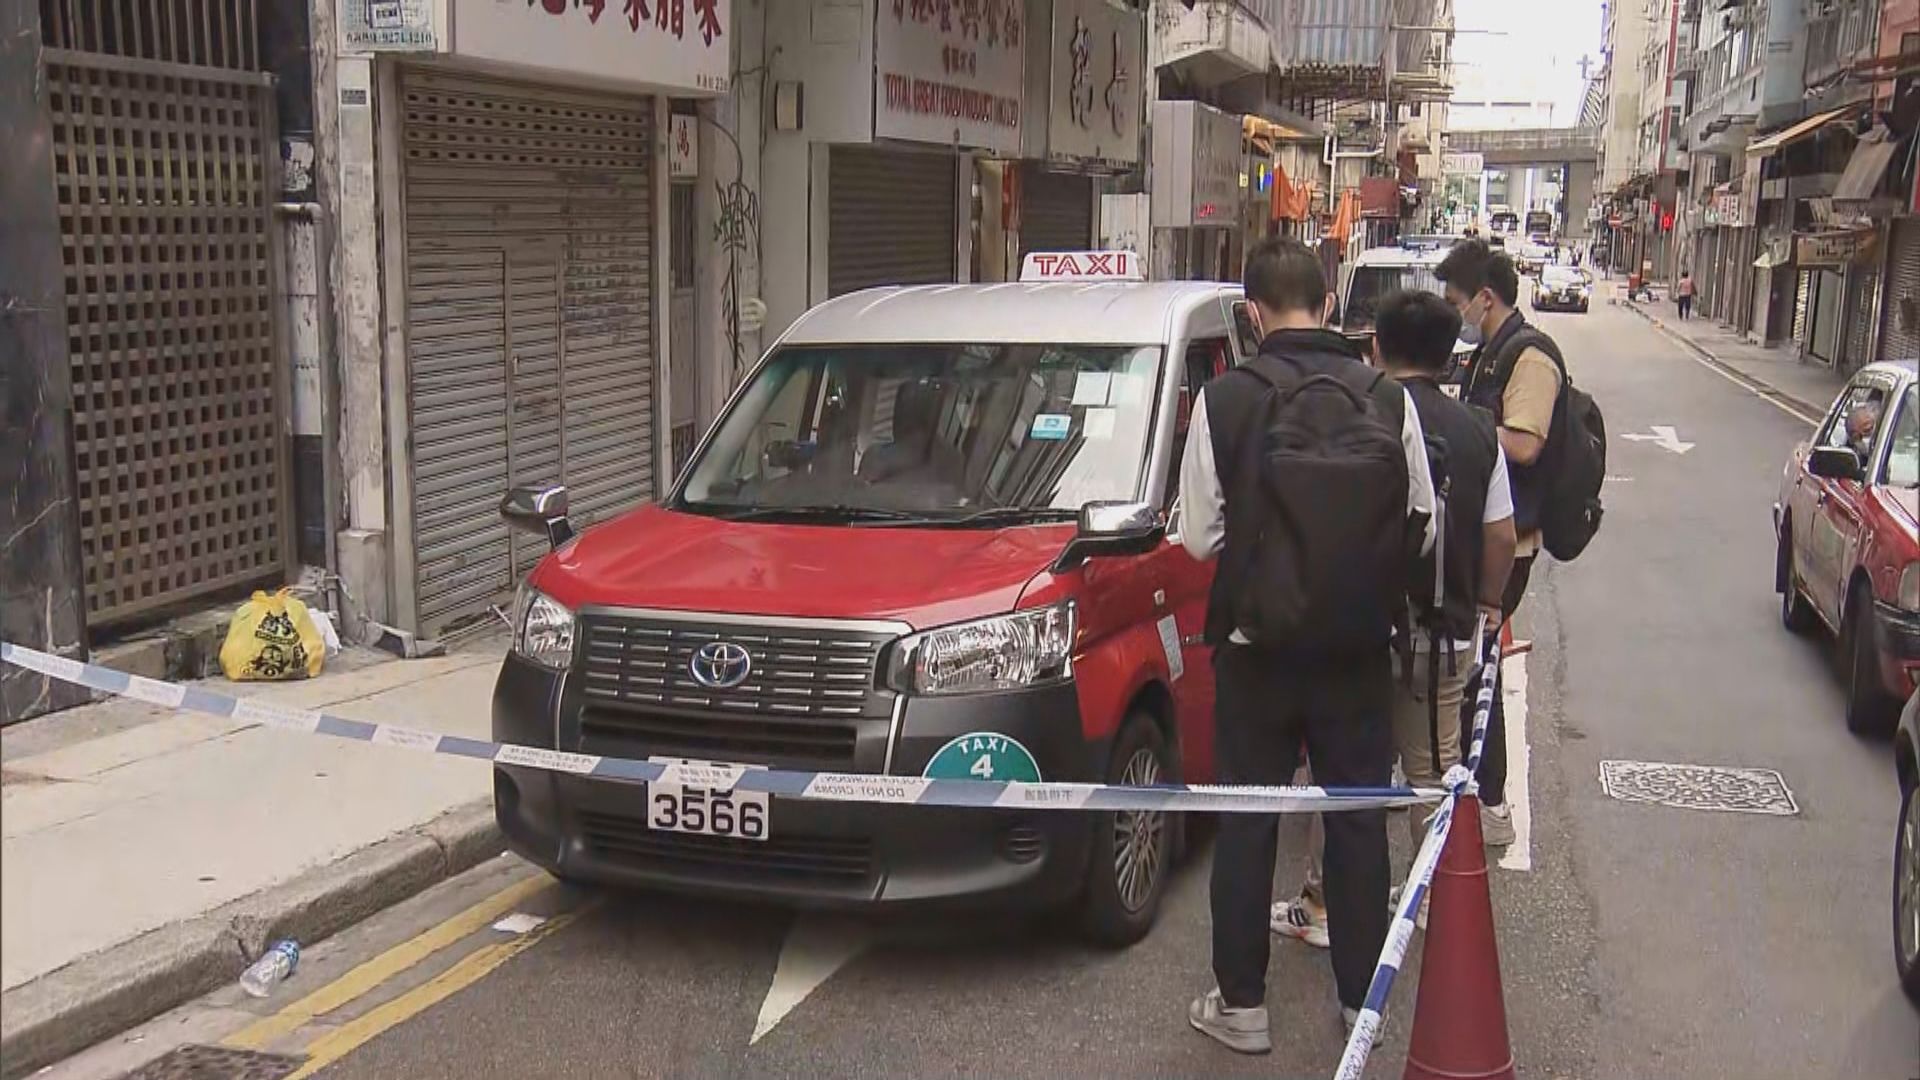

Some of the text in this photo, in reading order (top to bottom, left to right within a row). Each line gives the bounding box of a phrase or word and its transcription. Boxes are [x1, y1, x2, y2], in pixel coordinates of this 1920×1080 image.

[884, 73, 912, 112] TOTAL
[1033, 254, 1126, 275] TAXI
[958, 737, 1008, 754] TAXI
[970, 753, 994, 779] 4
[654, 794, 763, 838] 3566
